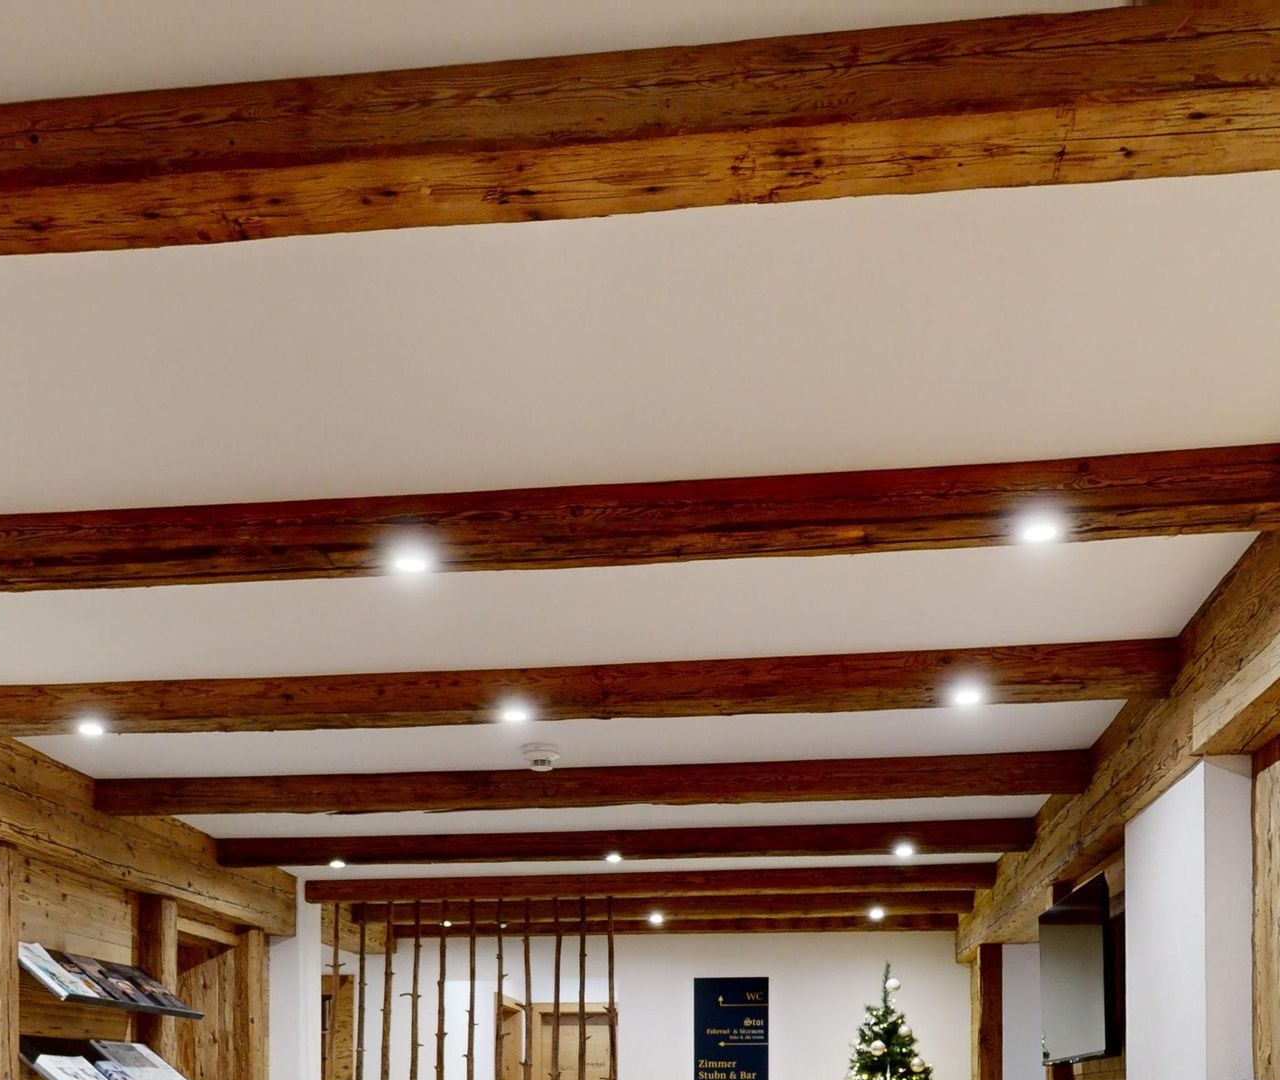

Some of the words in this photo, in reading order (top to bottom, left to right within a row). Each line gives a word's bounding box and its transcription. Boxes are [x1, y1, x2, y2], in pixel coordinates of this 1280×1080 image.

[746, 992, 764, 1001] WC
[698, 1059, 737, 1068] Zimmer
[698, 1071, 727, 1080] Stubn
[729, 1071, 737, 1080] &
[740, 1071, 757, 1080] Bar
